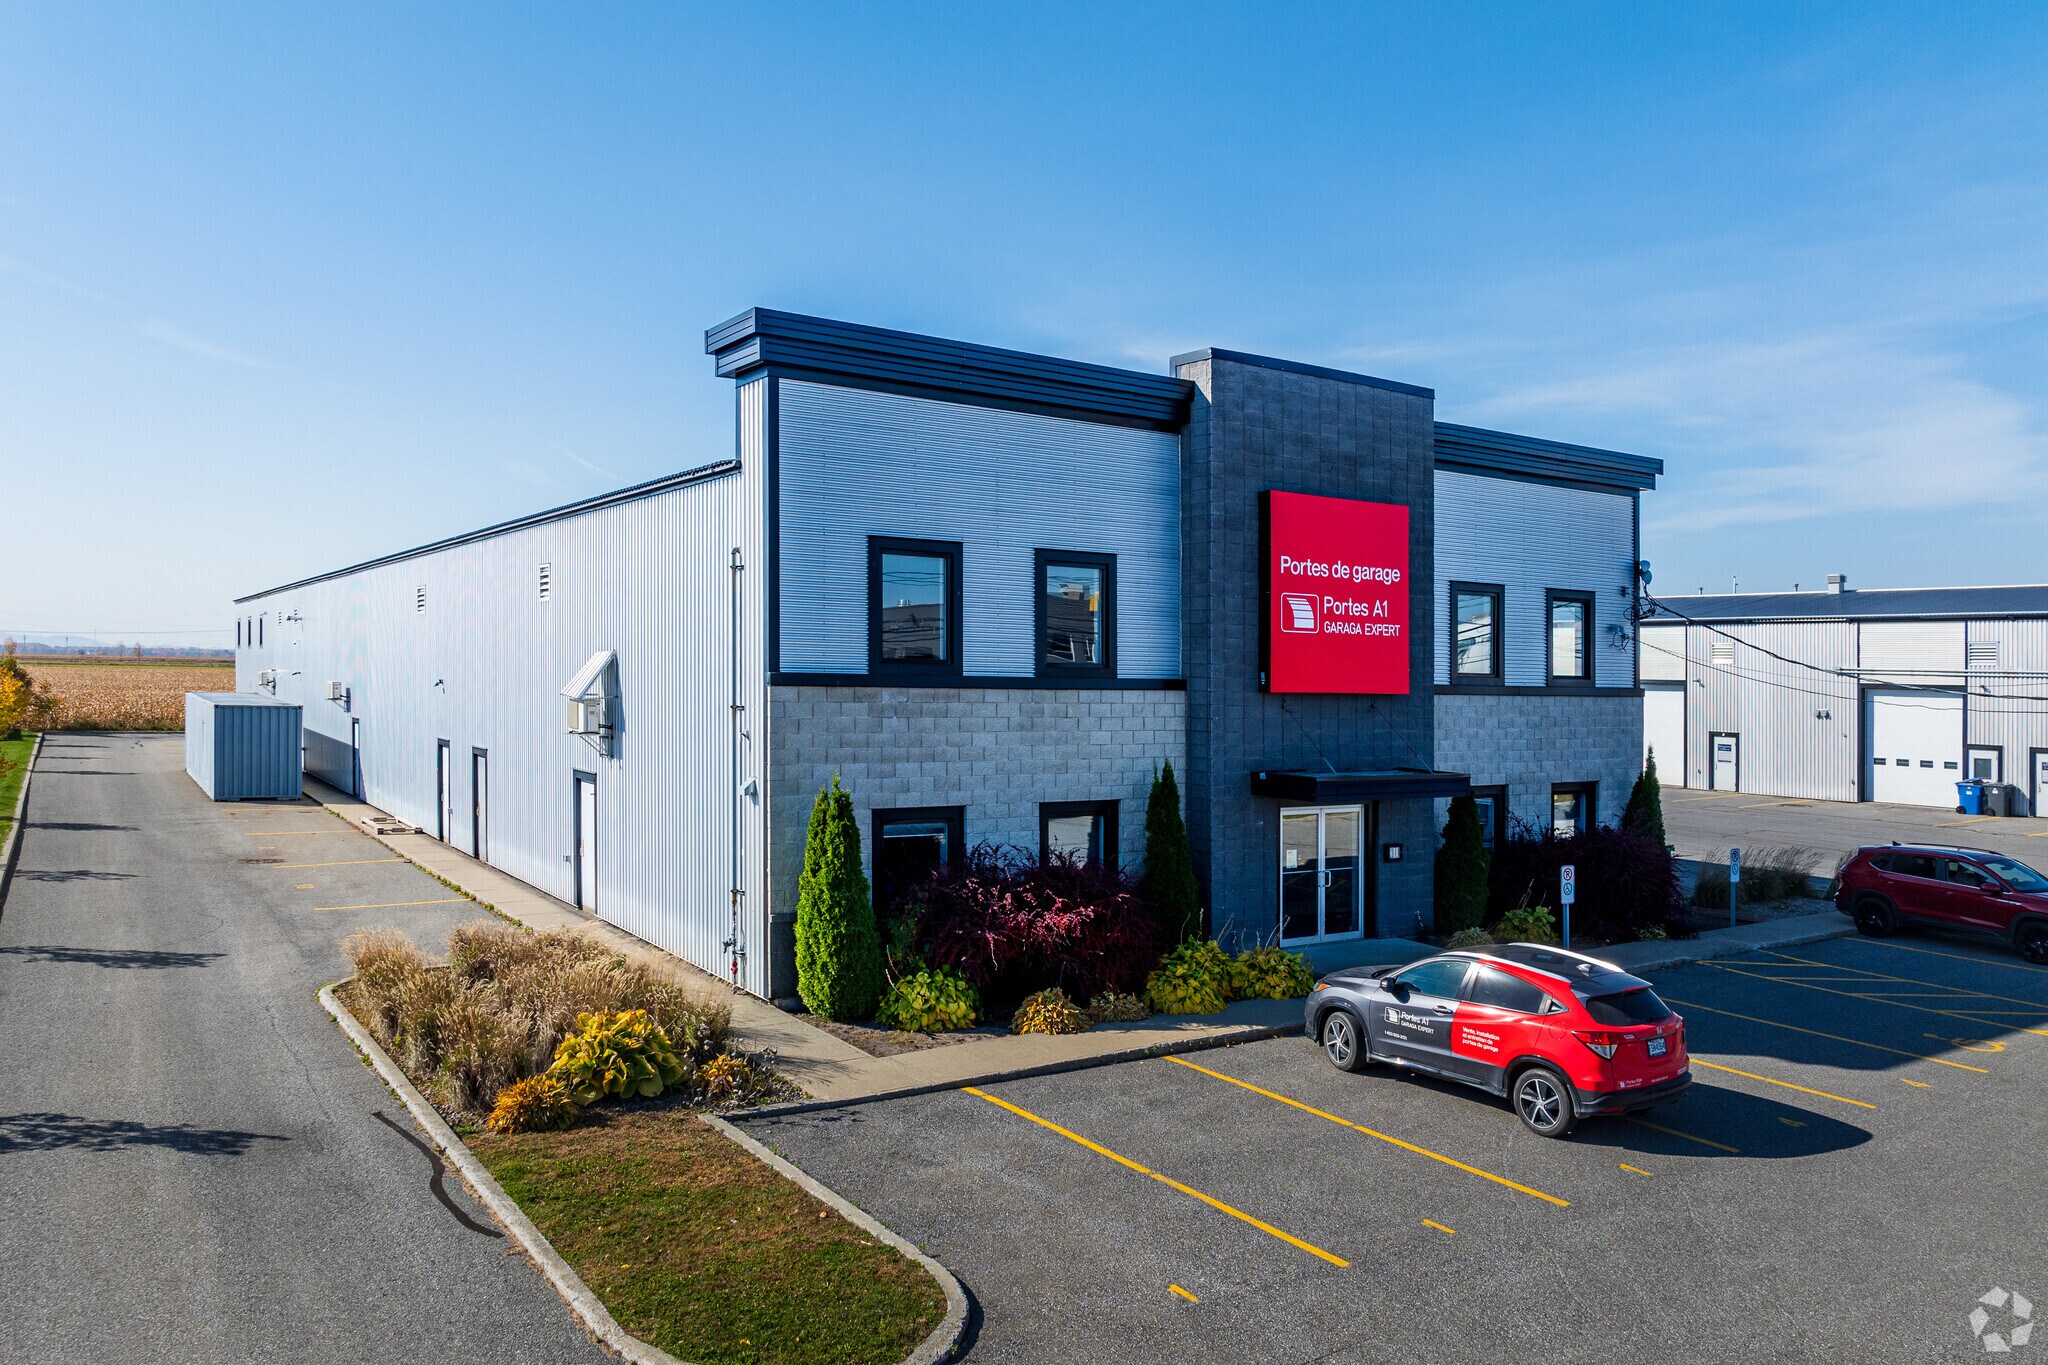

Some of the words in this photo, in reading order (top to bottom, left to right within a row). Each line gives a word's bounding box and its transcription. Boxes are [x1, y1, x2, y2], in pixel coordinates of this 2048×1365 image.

[1280, 555, 1329, 578] Portes
[1331, 560, 1350, 579] de
[1352, 565, 1400, 585] garage
[1323, 596, 1369, 617] Portes
[1372, 599, 1388, 618] A1
[1323, 621, 1363, 635] GARAGA
[1364, 623, 1400, 637] EXPERT
[1400, 1011, 1421, 1024] Portes
[1421, 1017, 1430, 1026] A1
[1417, 1025, 1435, 1035] EXPERT
